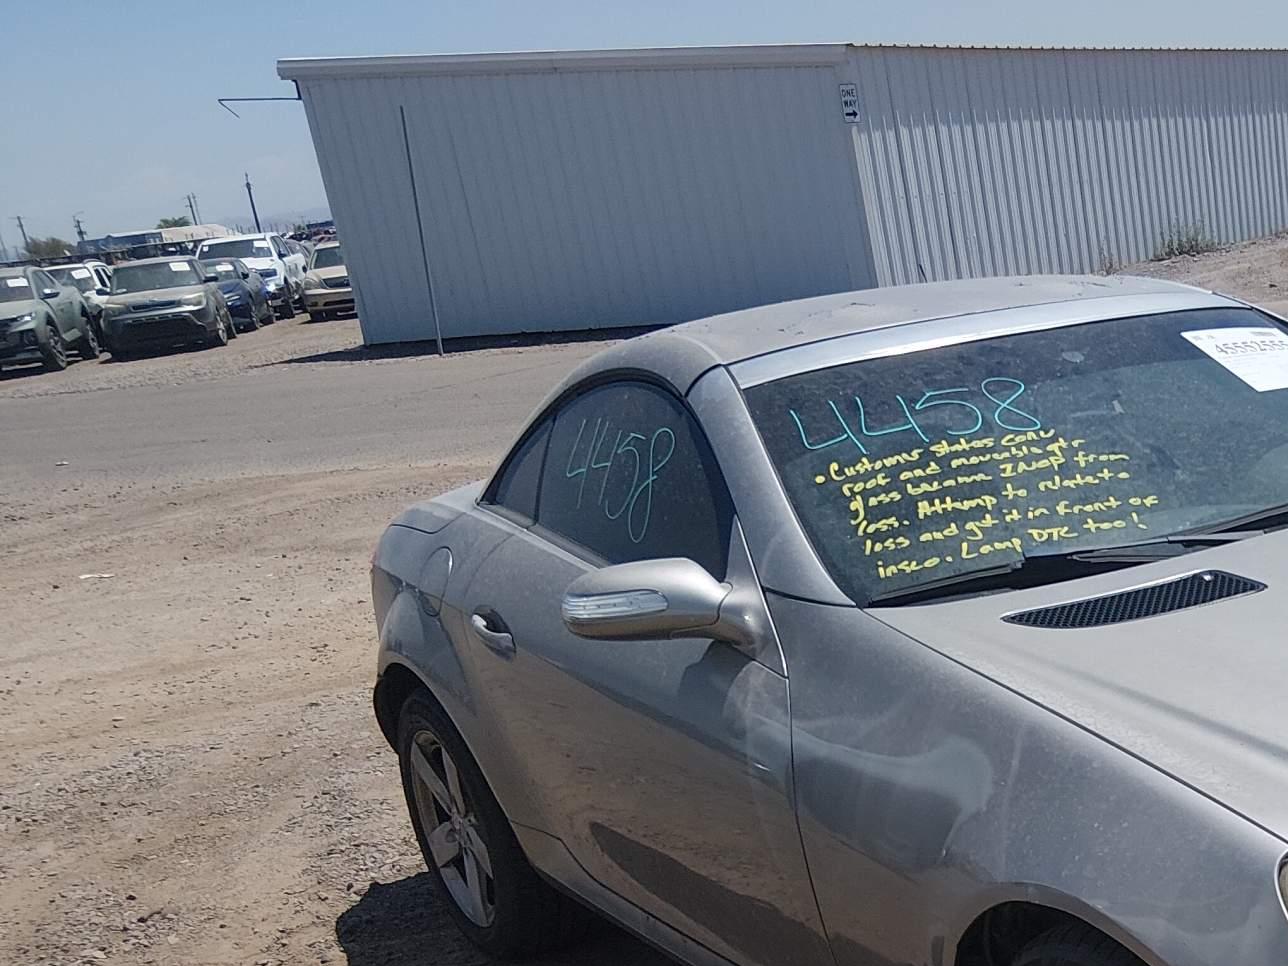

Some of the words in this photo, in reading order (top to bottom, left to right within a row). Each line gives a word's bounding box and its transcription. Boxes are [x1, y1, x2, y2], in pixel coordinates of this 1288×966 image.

[789, 377, 1041, 455] 4458
[1073, 451, 1130, 468] from
[566, 417, 675, 544] 4458
[842, 472, 892, 497] roof
[899, 461, 942, 481] and
[1001, 483, 1028, 500] to
[865, 536, 911, 556] loss
[919, 522, 960, 542] and
[1027, 507, 1050, 520] in
[1055, 496, 1123, 516] front
[1128, 495, 1159, 508] of
[961, 537, 1023, 560] Lamp
